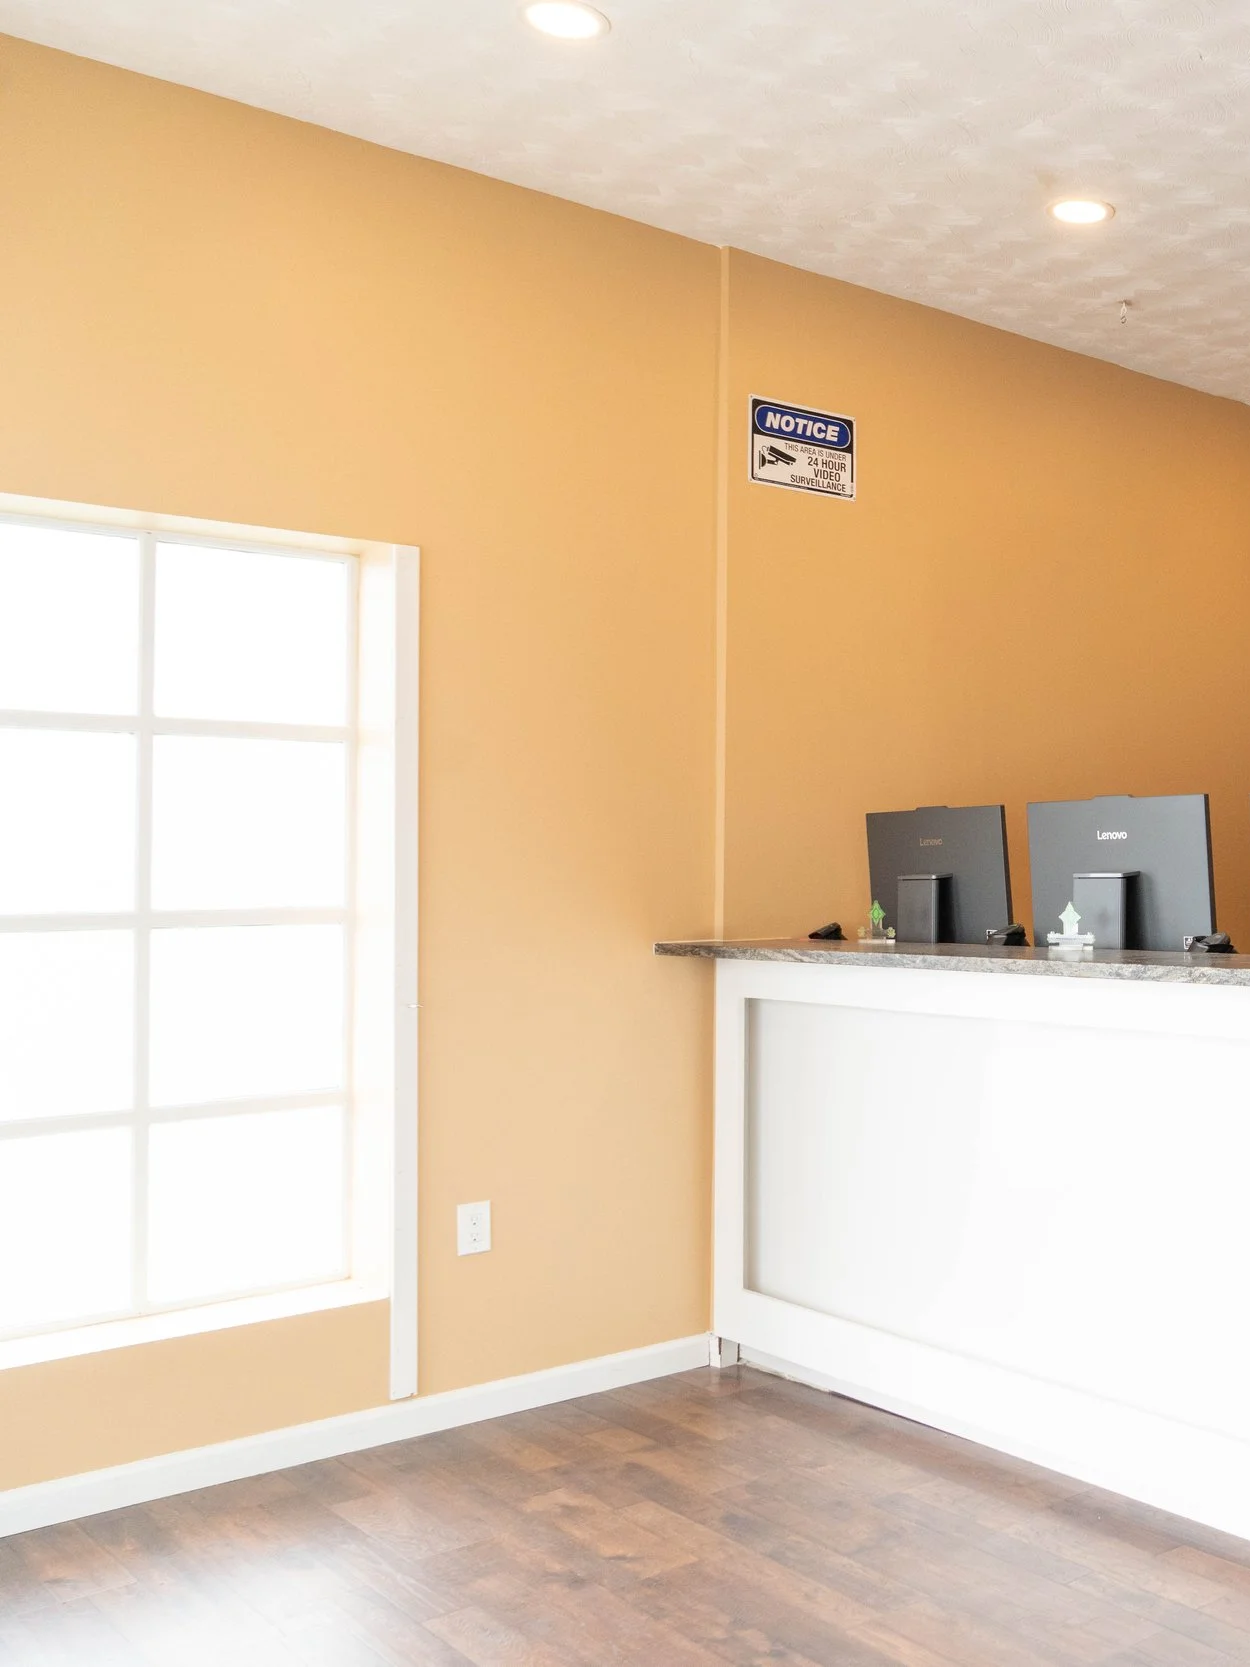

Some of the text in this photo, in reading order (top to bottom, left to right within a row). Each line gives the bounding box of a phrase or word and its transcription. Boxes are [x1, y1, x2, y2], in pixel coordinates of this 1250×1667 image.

[765, 411, 840, 442] NOTICE
[784, 442, 847, 461] THIS AREA IS UNDER
[807, 456, 847, 472] 24 HOUR
[790, 474, 847, 492] SURVEILLANCE
[813, 468, 841, 482] VIDEO
[1096, 830, 1128, 840] Lenovo
